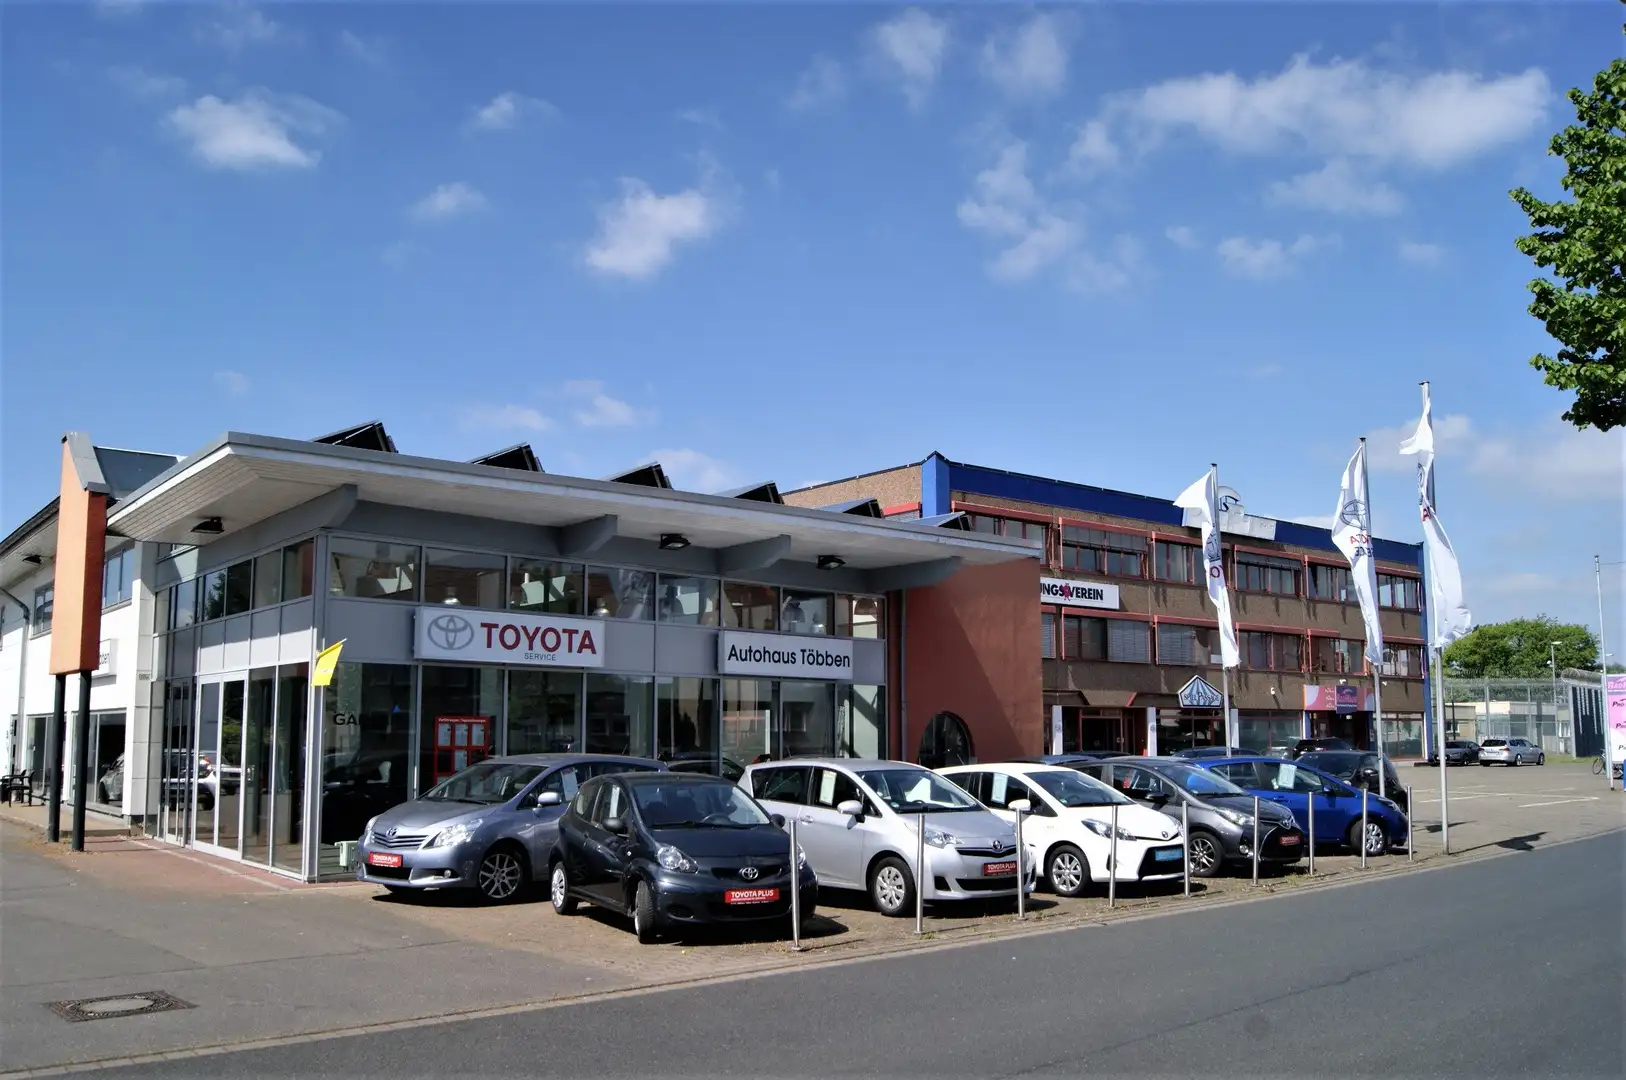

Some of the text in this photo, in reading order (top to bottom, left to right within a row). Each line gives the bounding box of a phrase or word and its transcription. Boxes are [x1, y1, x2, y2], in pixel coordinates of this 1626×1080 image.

[480, 622, 597, 655] TOYOTA
[524, 652, 557, 661] SERVICE
[727, 644, 851, 667] Autohaus Többen
[731, 889, 774, 898] TOYOTA PLUS
